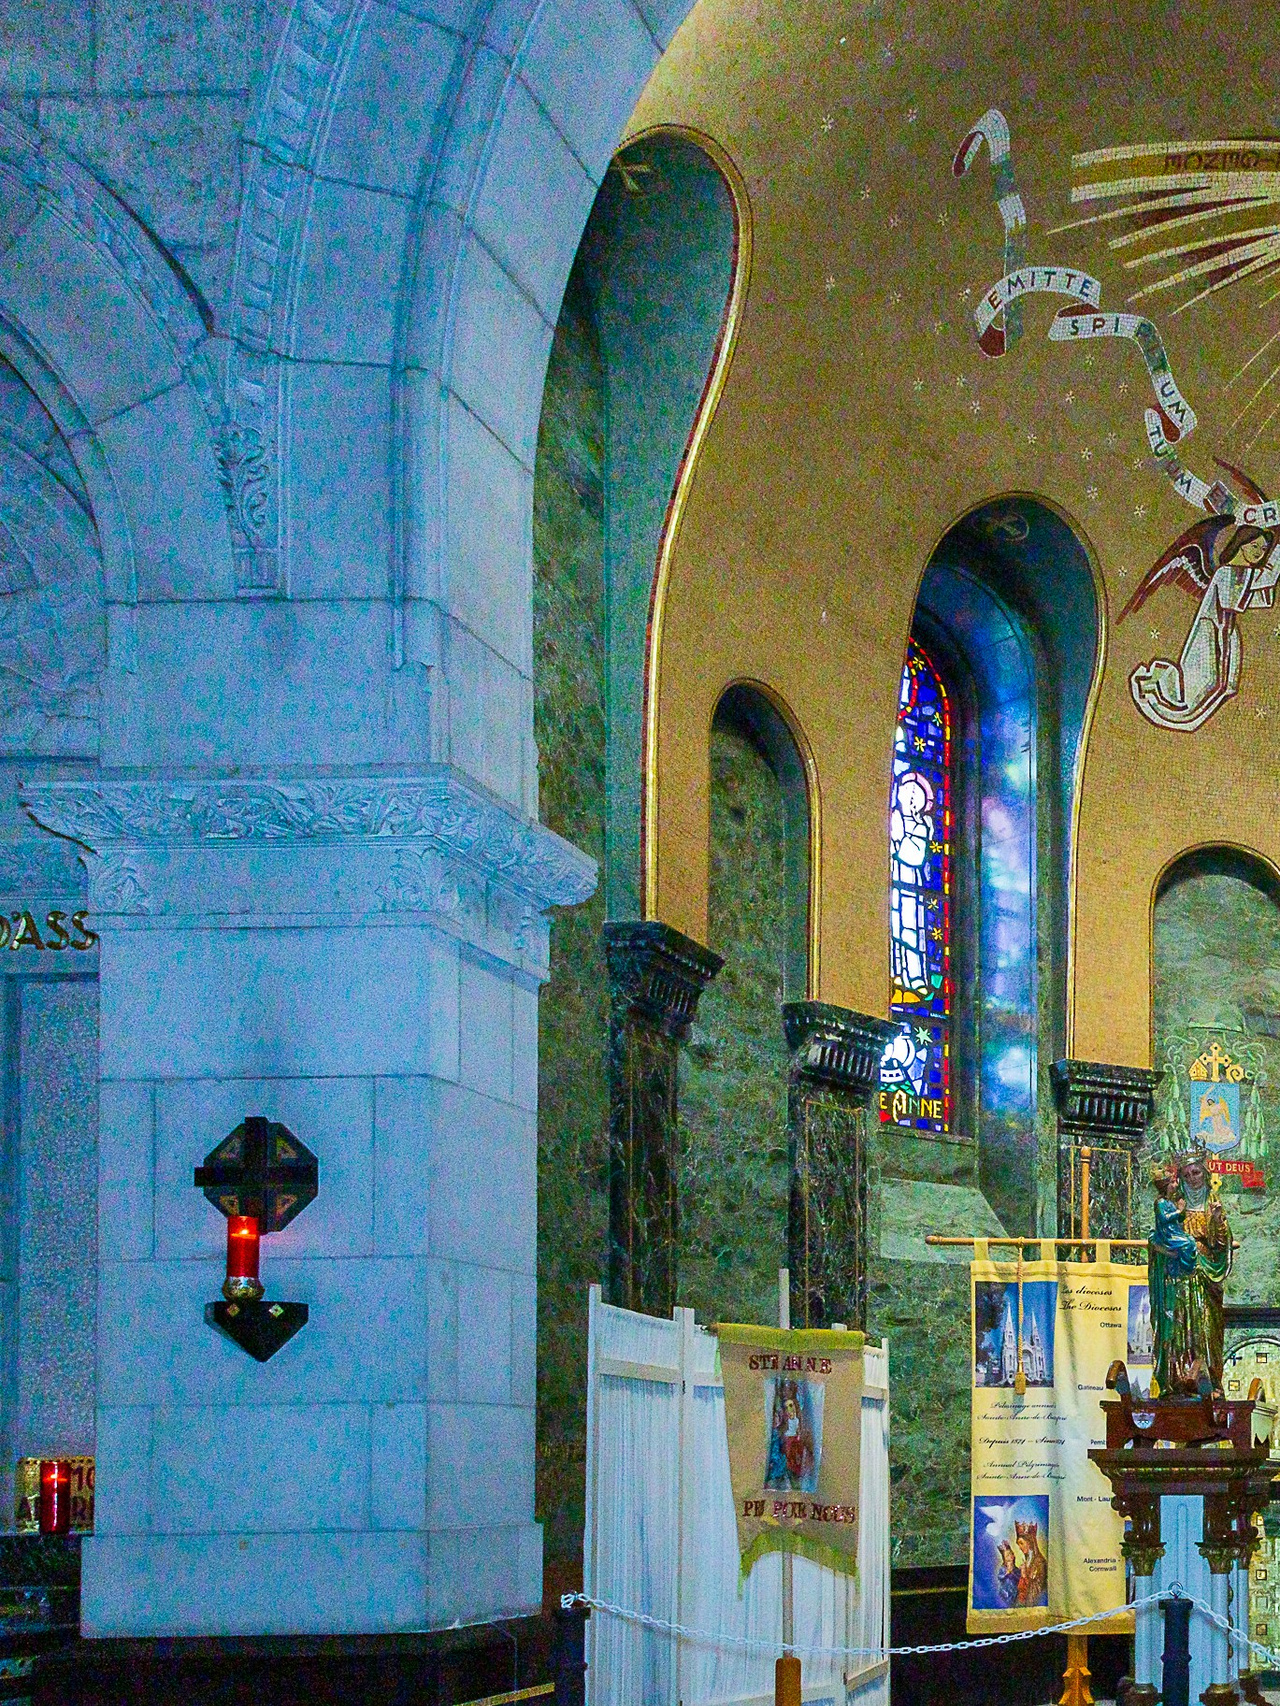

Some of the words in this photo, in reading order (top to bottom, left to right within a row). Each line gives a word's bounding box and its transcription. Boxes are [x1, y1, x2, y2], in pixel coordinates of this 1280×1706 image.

[988, 270, 1094, 310] EMITTE
[893, 1090, 942, 1122] ANNE
[1208, 1161, 1221, 1171] UT
[1225, 1162, 1251, 1173] DEUS
